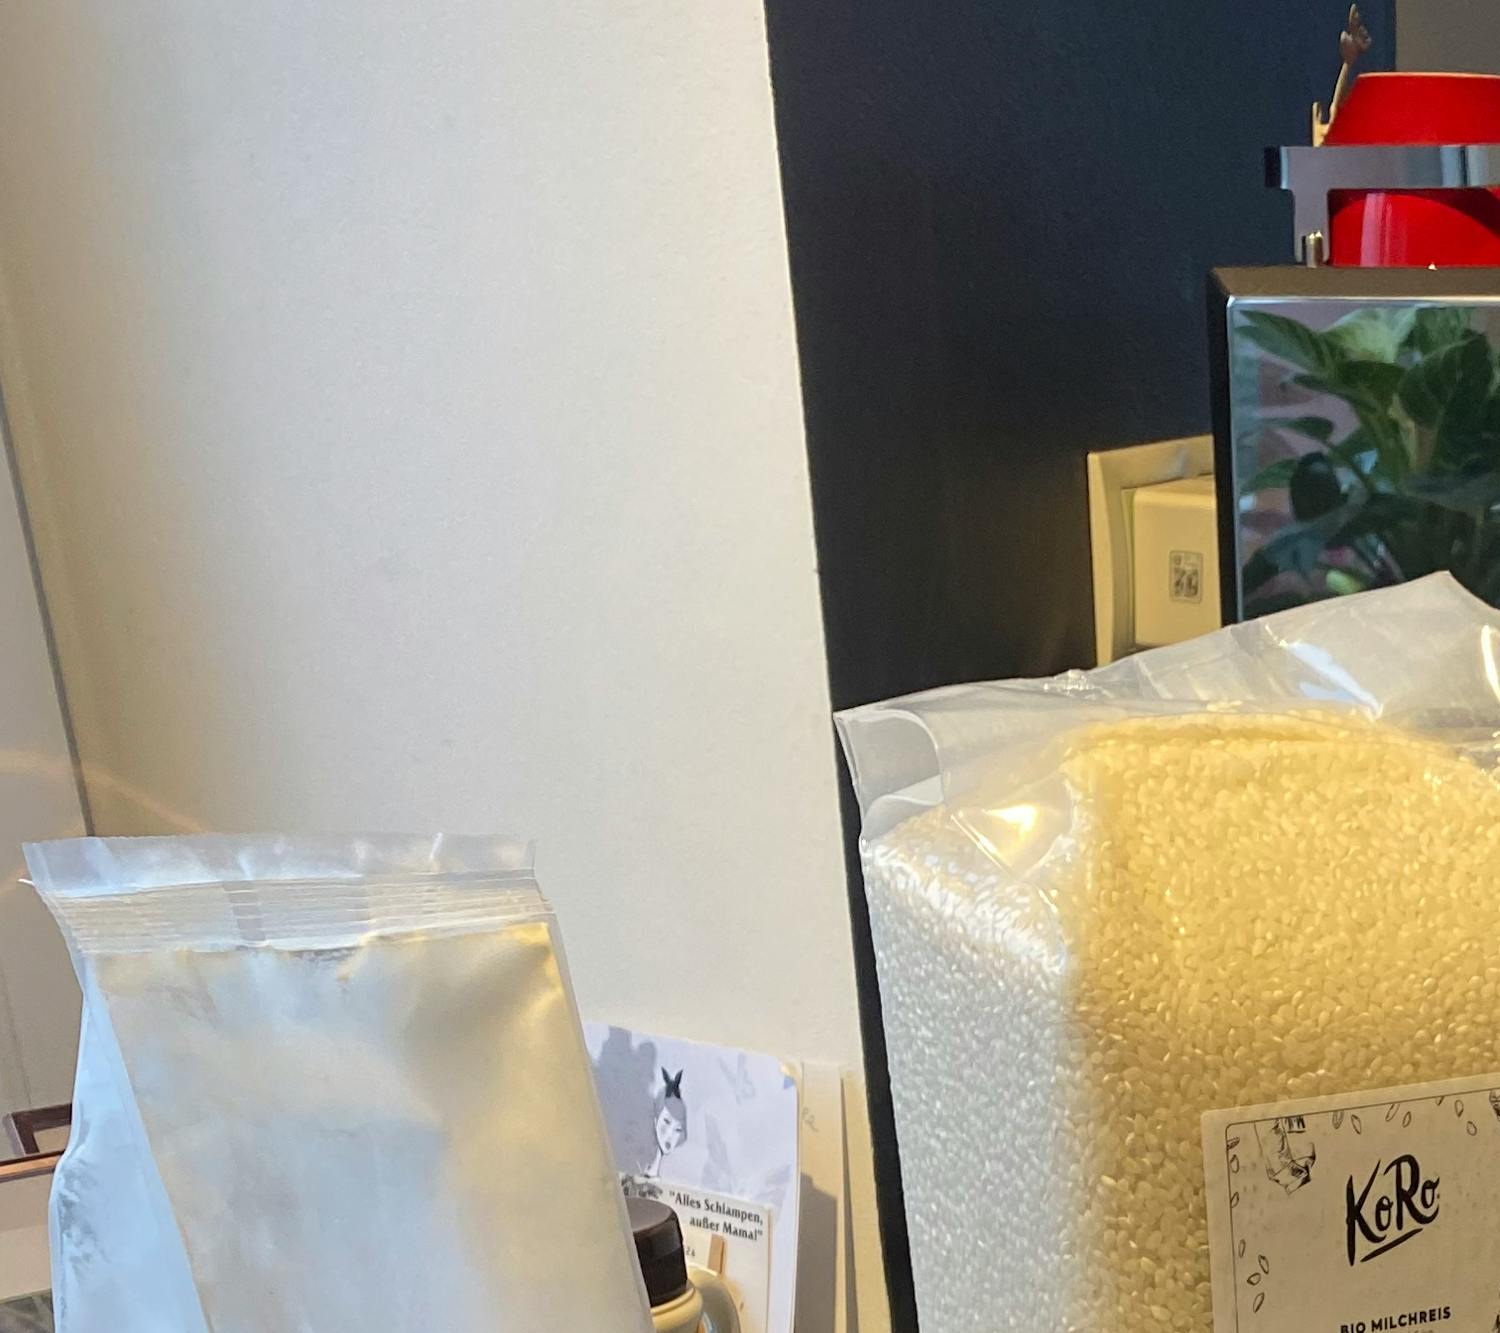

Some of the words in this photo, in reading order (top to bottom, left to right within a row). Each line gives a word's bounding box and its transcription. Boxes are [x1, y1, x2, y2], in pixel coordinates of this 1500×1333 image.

[689, 1216, 720, 1231] außer
[704, 1198, 763, 1226] Schlampen,
[1345, 1154, 1440, 1267] KoRo
[1371, 1306, 1451, 1332] MILCHREIS
